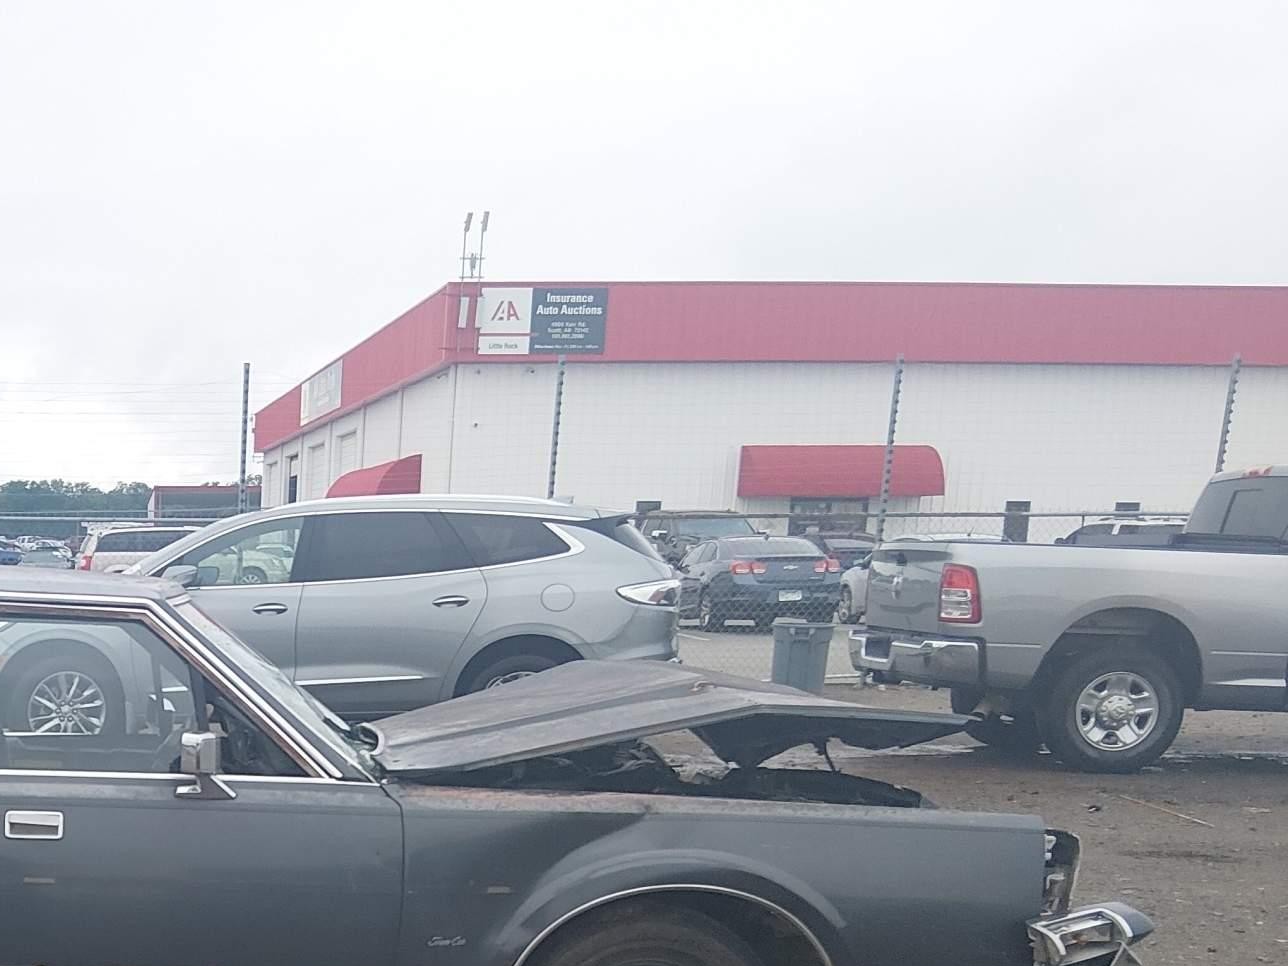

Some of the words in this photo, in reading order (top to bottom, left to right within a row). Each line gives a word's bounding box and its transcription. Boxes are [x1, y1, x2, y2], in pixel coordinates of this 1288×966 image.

[547, 293, 594, 303] Insurance
[536, 305, 559, 315] Auto
[561, 304, 602, 315] Auctions
